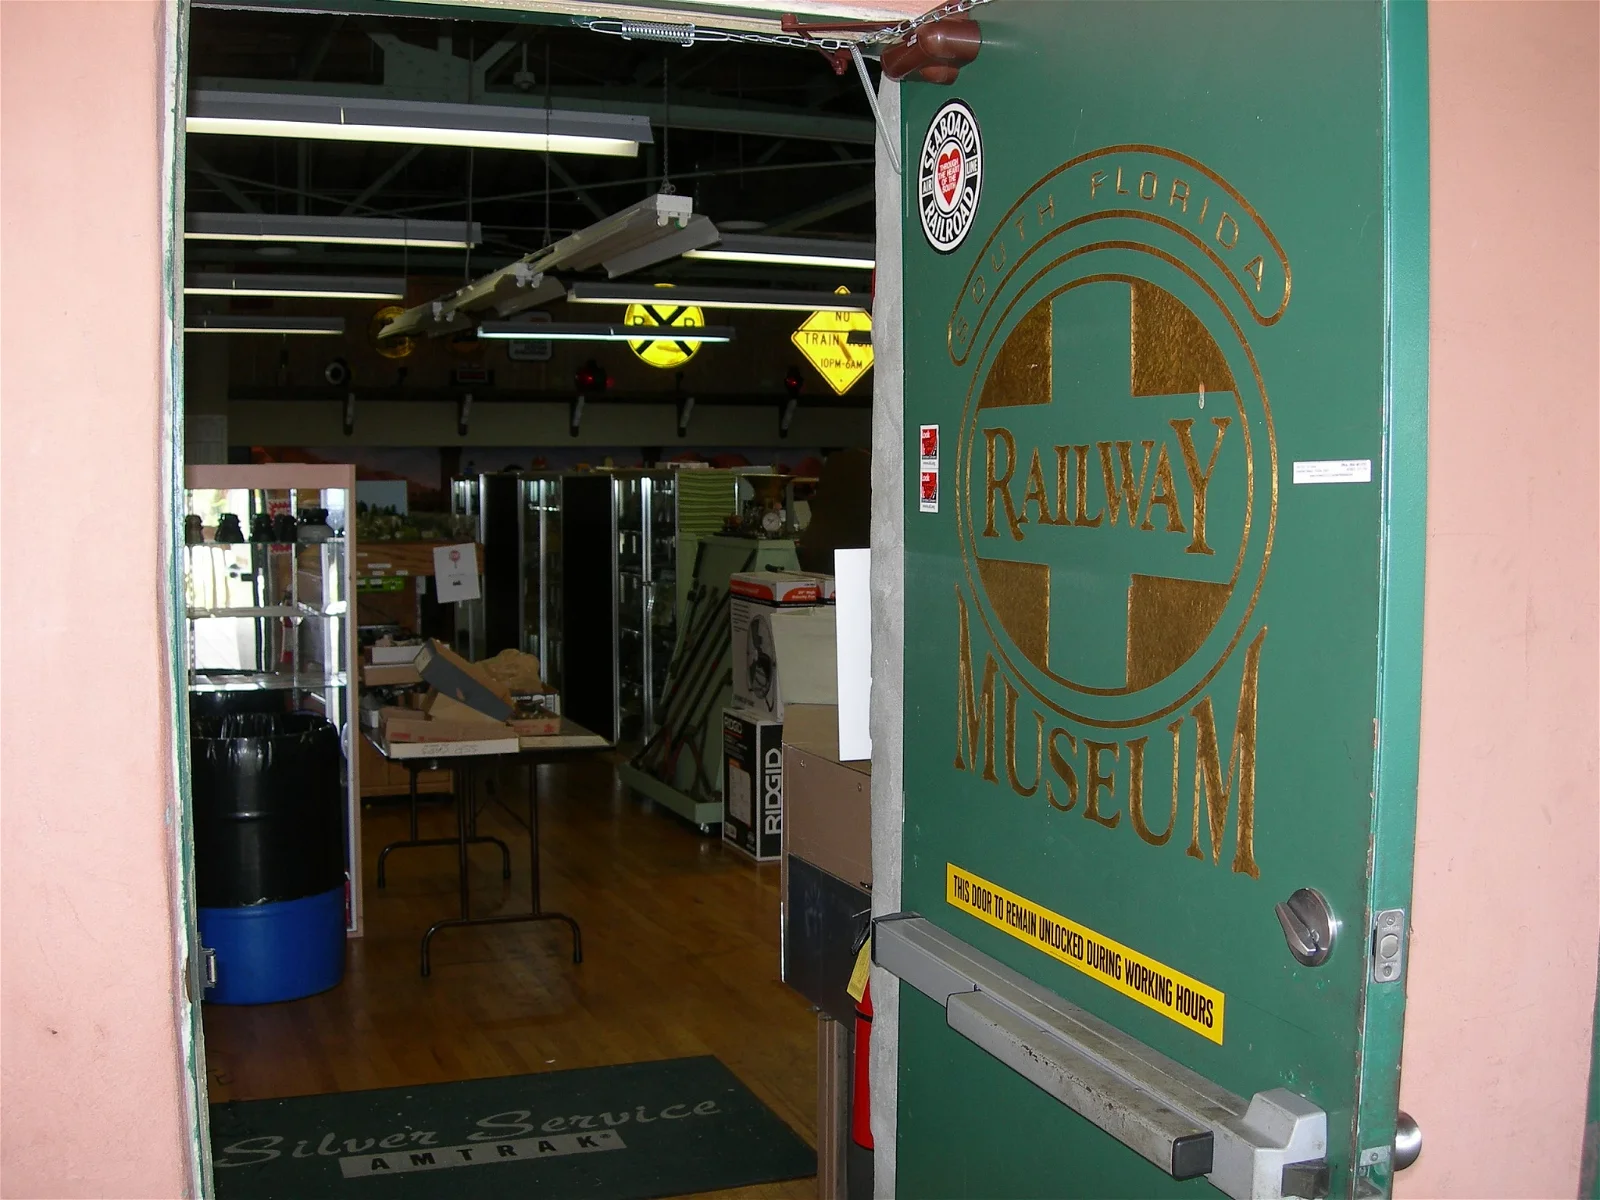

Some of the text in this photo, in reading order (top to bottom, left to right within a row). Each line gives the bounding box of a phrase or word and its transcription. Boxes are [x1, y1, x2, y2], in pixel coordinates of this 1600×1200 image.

[925, 112, 975, 171] SEABOARD
[922, 158, 978, 194] AIR LINE
[924, 186, 975, 242] RAILROAD
[957, 165, 1265, 345] SOUTH FLORIDA
[805, 332, 840, 346] TRAIN
[835, 311, 850, 322] NO
[820, 358, 863, 370] 10PM-6AM
[981, 417, 1232, 556] RAILWAY
[953, 582, 1268, 880] MUSEUM
[765, 747, 783, 835] RIDGID
[953, 874, 970, 903] THIS
[972, 884, 992, 915] DOOR
[993, 894, 1004, 921] TO
[1006, 900, 1037, 938] REMAIN
[1038, 917, 1084, 961] UNLOCKED
[1086, 939, 1122, 981] DURING
[1124, 958, 1173, 1007] WORKING
[1175, 983, 1214, 1029] HOURS
[214, 1100, 723, 1167] Silver Service
[370, 1134, 605, 1171] AMTRAK
